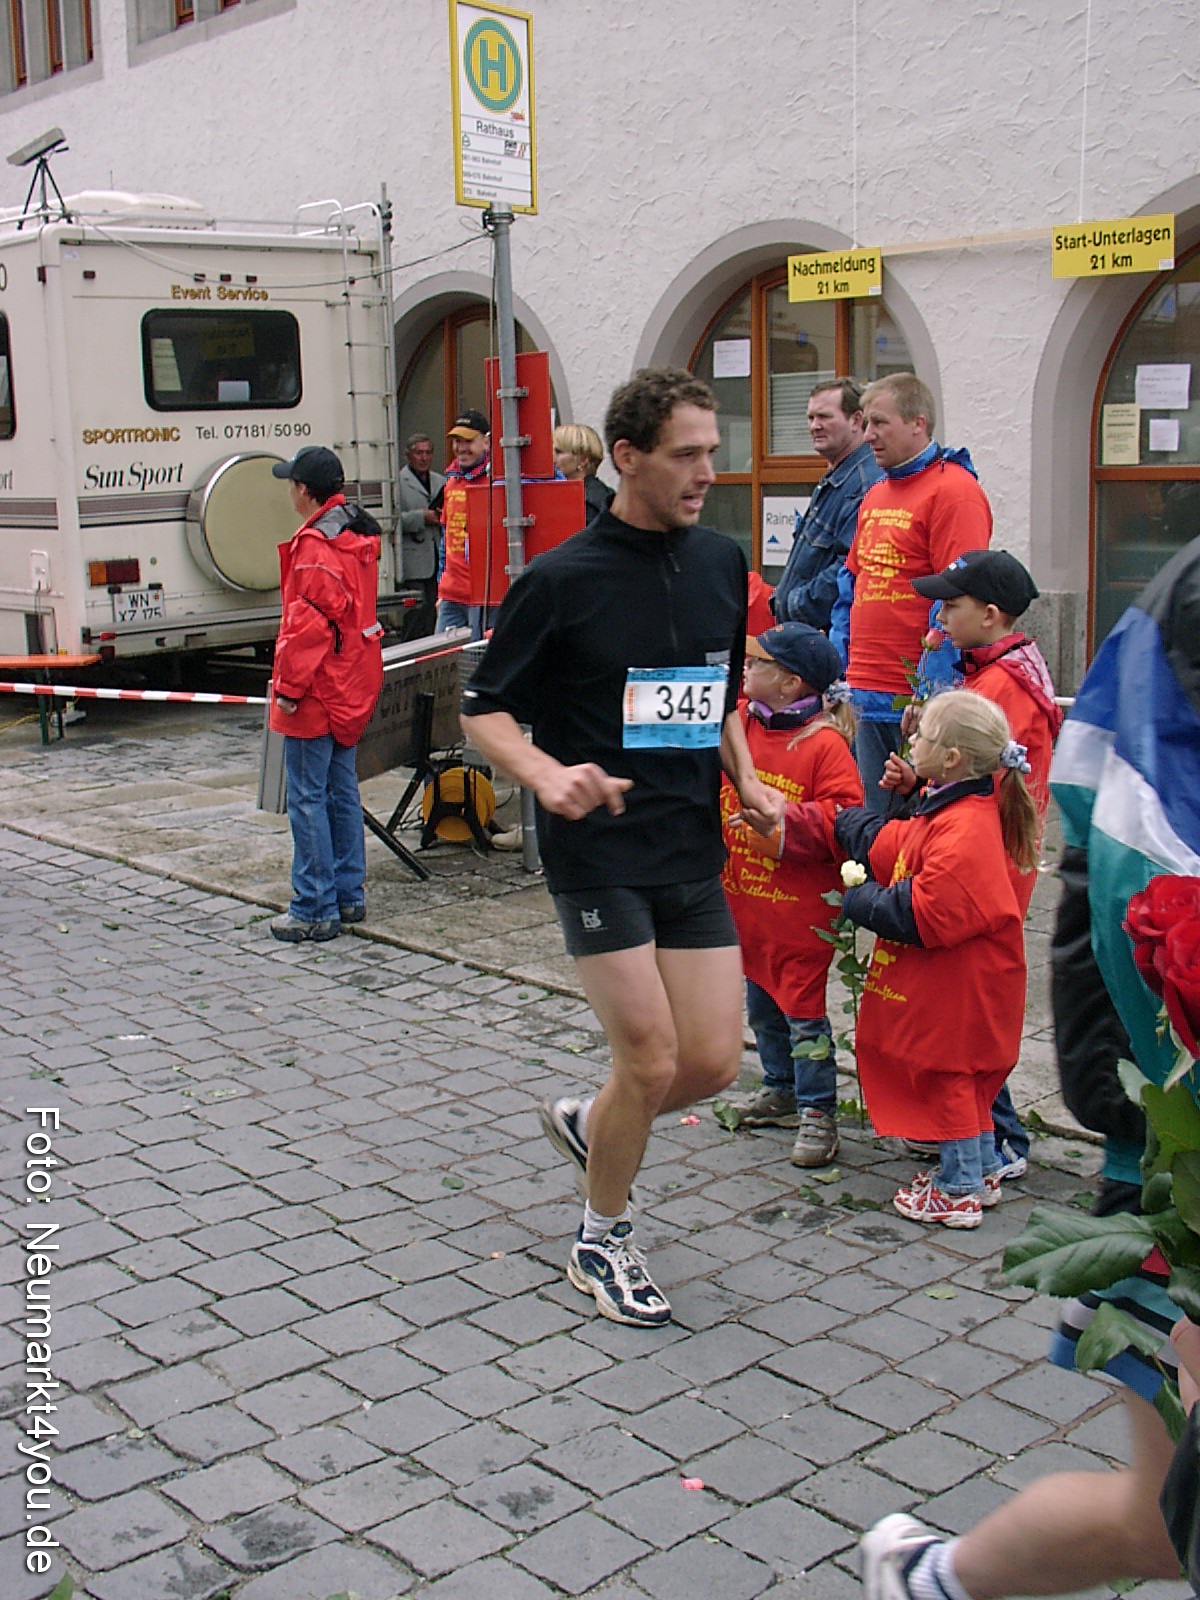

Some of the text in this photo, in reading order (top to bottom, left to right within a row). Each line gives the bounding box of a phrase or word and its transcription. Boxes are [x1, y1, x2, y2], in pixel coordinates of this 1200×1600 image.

[480, 39, 507, 92] H
[476, 120, 515, 139] Rathaus
[1055, 227, 1171, 251] Start-Unterlagen
[793, 256, 875, 277] Nachmeldung
[1090, 252, 1132, 270] 21 km
[171, 285, 269, 300] Event Service
[818, 280, 849, 294] 21 km
[82, 426, 181, 444] SPORTRONIC
[195, 425, 218, 439] Tel.
[127, 461, 184, 490] Sport
[128, 593, 149, 607] WN
[142, 607, 162, 620] 175
[656, 685, 712, 721] 345
